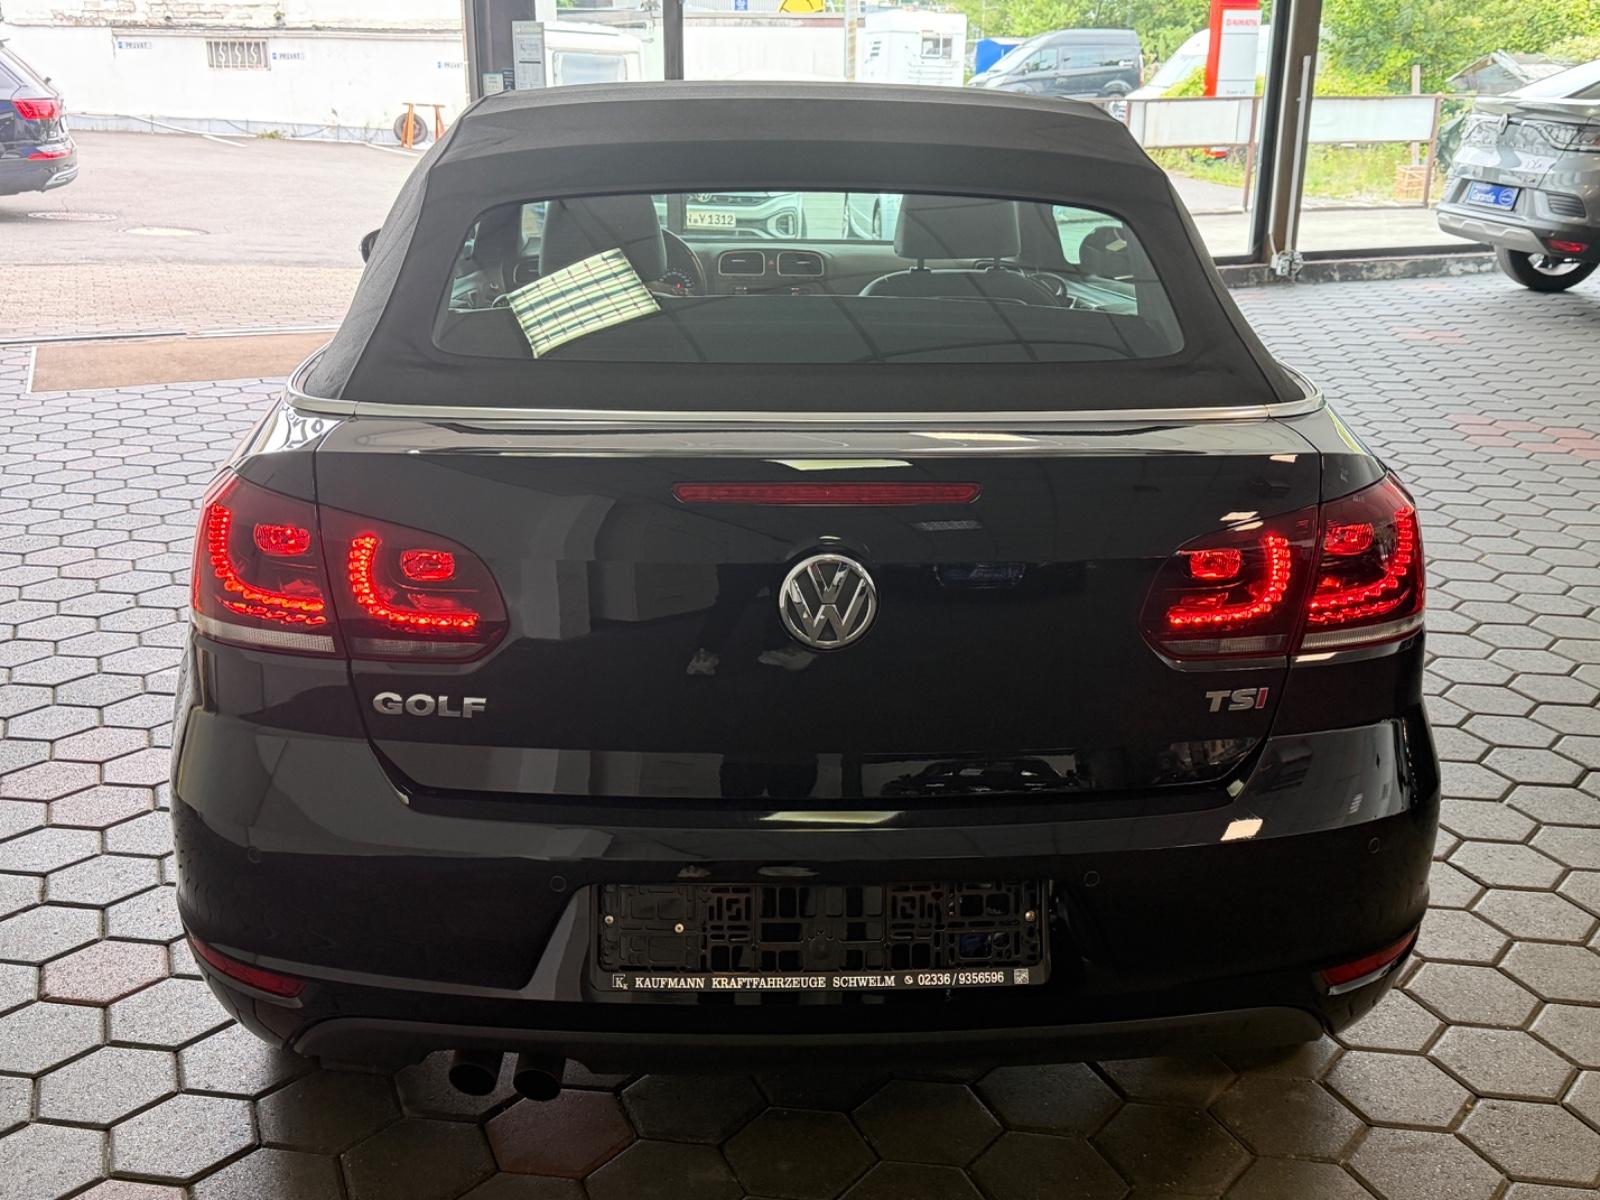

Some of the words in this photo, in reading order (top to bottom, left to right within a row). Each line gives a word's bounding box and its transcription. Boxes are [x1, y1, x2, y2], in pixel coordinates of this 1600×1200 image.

[707, 214, 734, 225] 1312
[372, 691, 487, 719] GOLF
[1205, 687, 1269, 713] TSI
[634, 977, 705, 989] KAUFMANN
[711, 976, 826, 989] KRAFTFAHRZEUGE
[832, 975, 896, 988] SCHWELM
